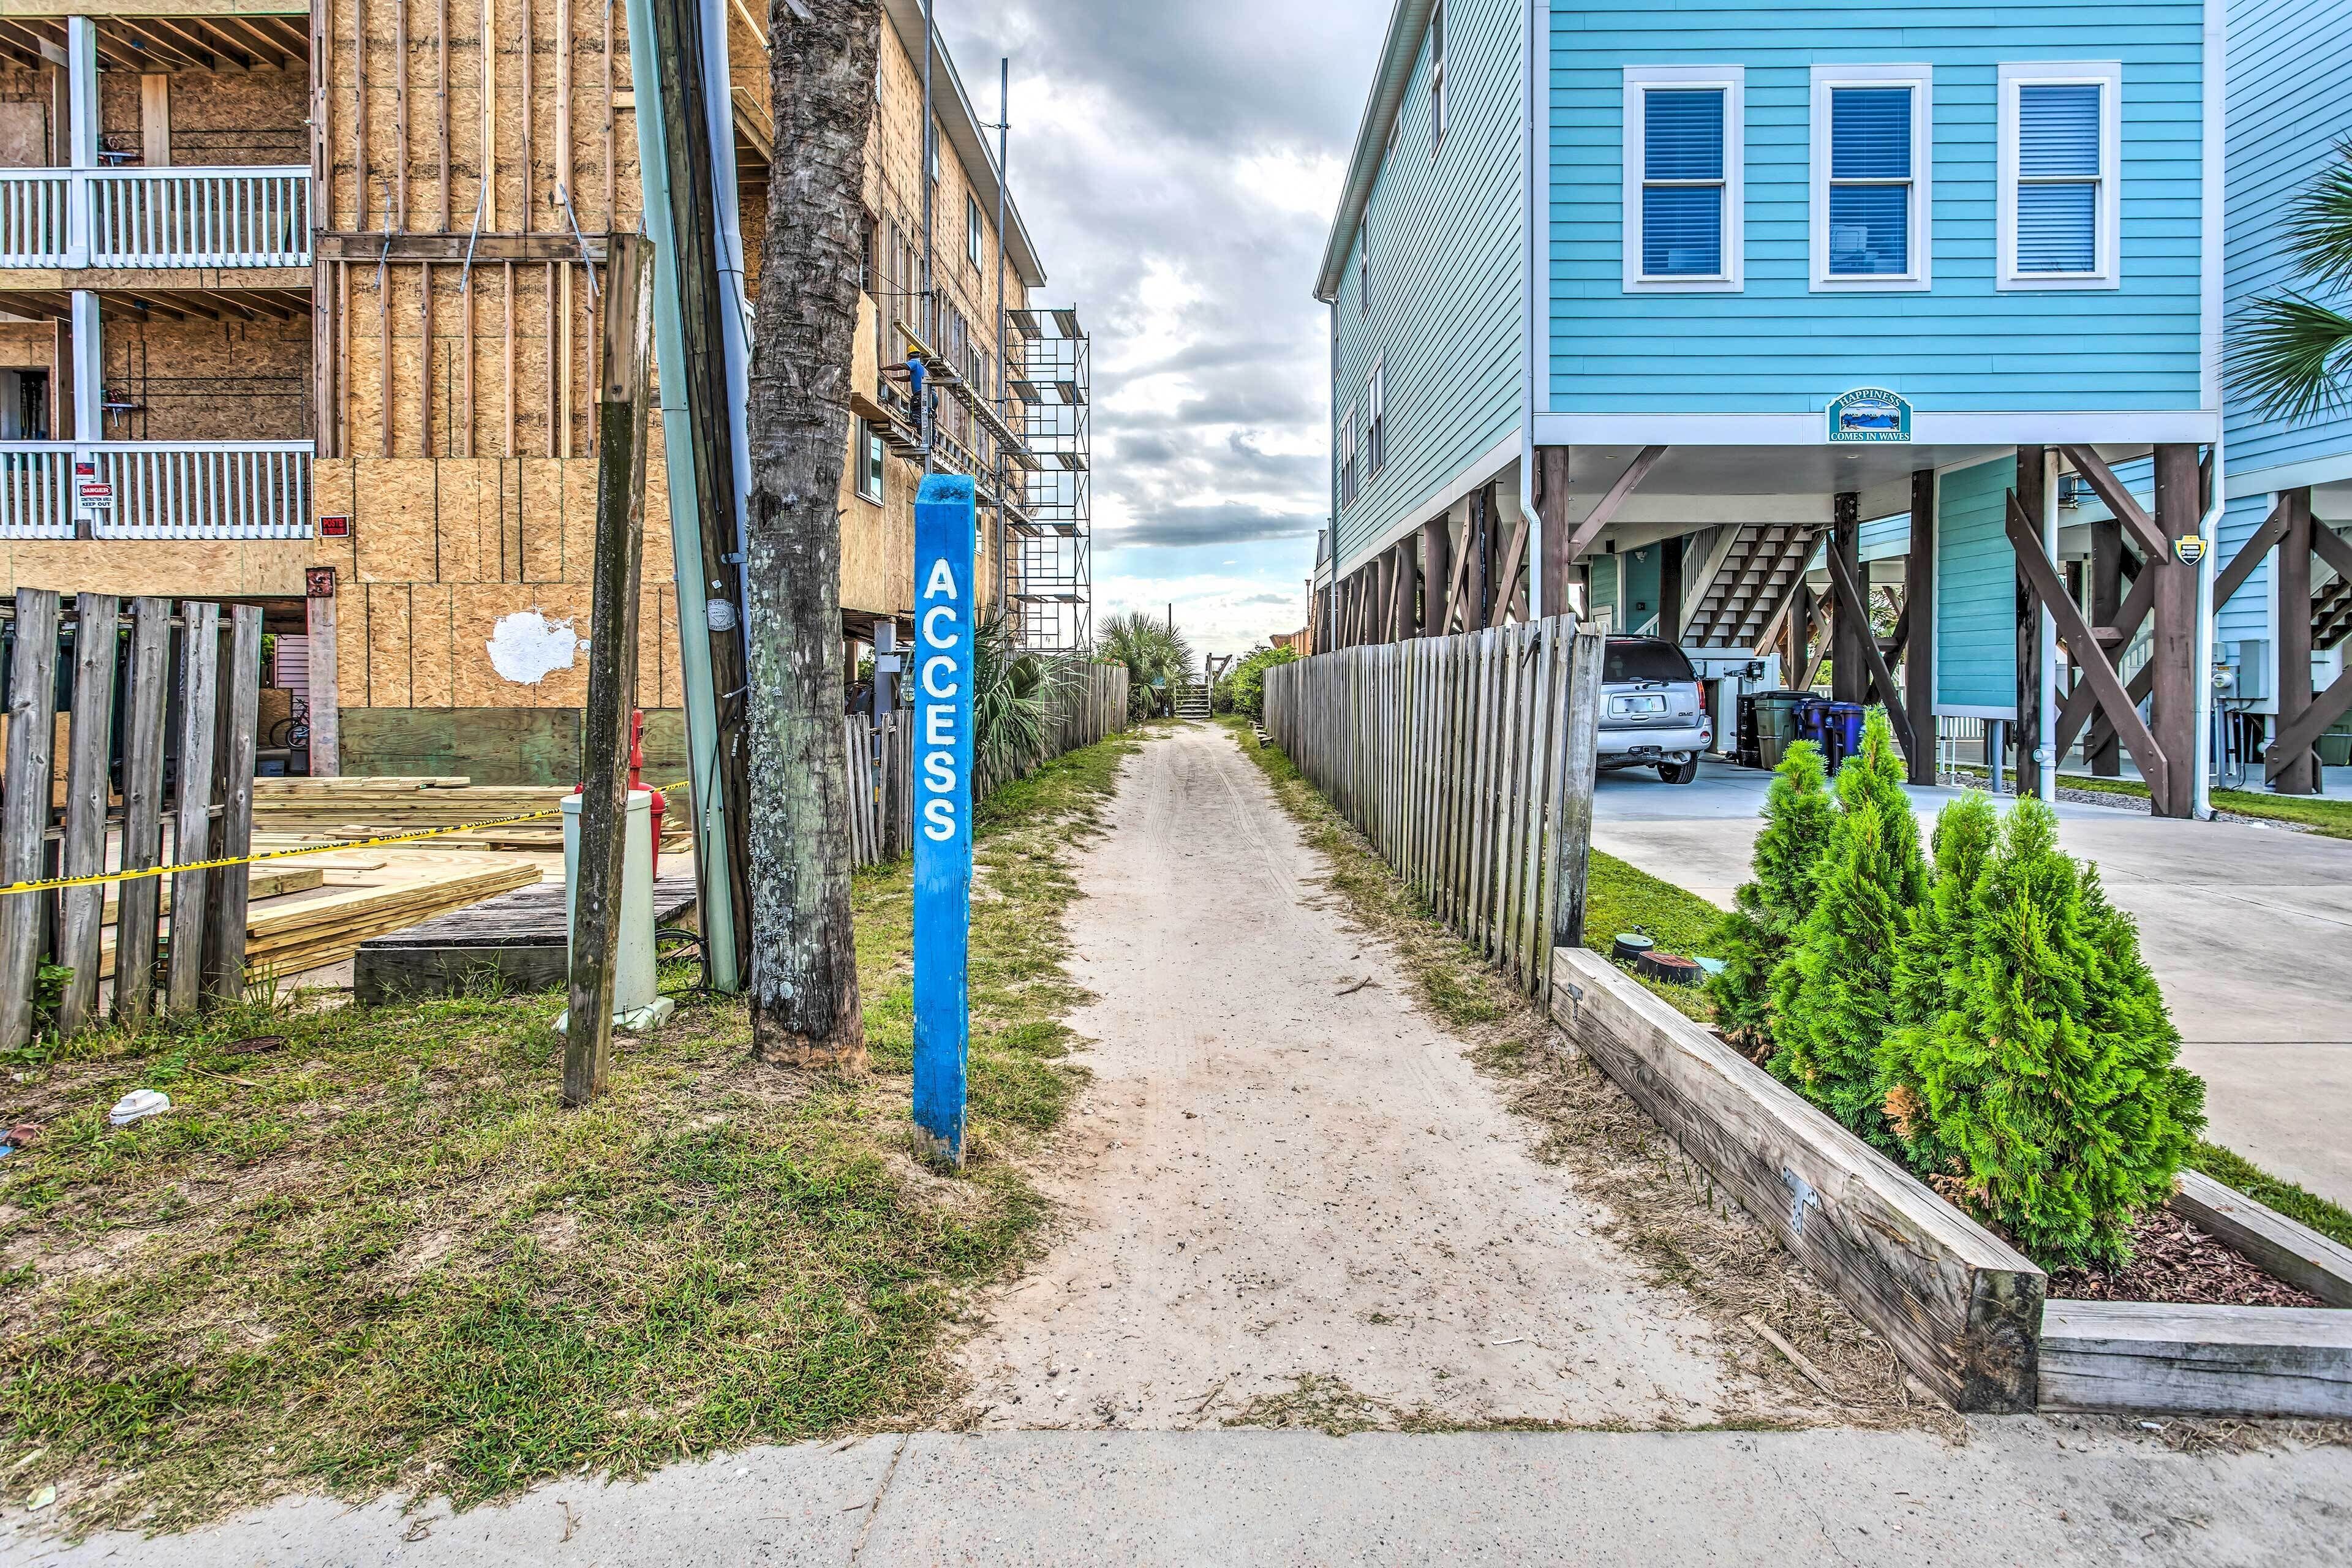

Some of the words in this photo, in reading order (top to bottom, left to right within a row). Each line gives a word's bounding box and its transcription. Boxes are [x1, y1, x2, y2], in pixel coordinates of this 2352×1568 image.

[1839, 390, 1901, 407] HAPPINESS
[1879, 432, 1910, 441] WAVES
[922, 557, 959, 842] ACCESS
